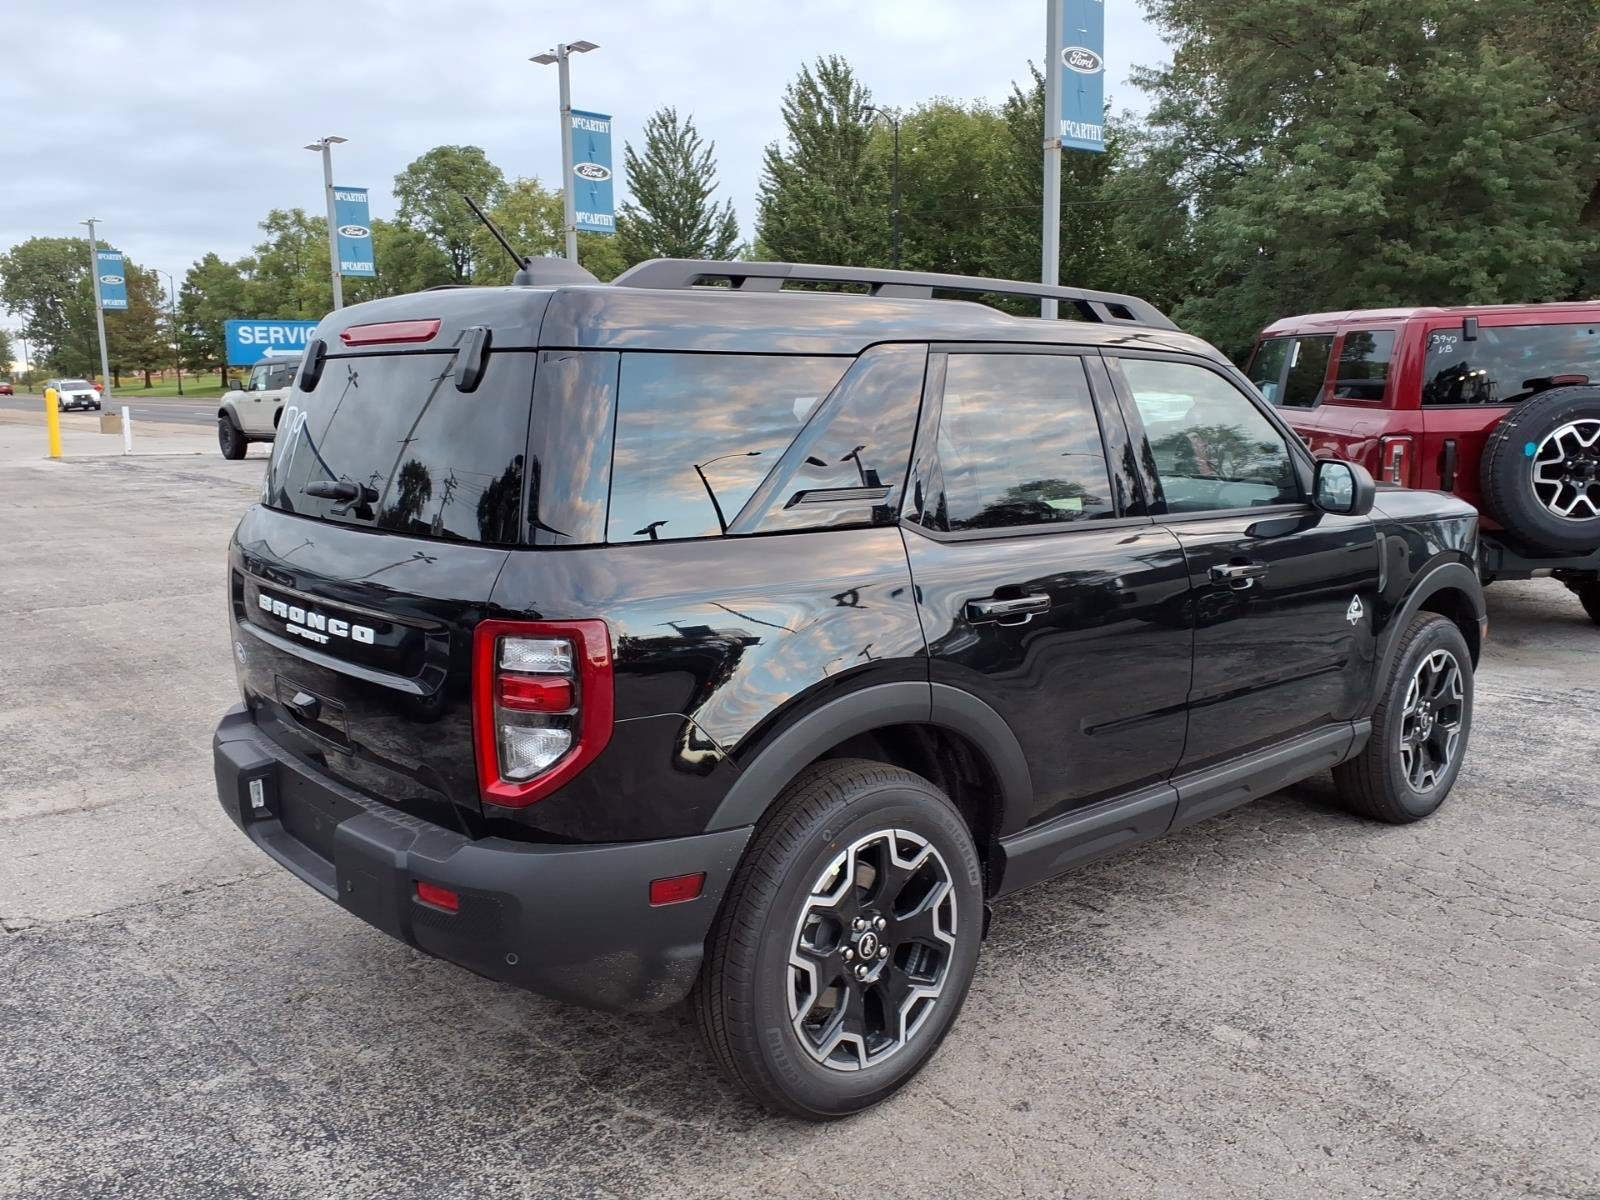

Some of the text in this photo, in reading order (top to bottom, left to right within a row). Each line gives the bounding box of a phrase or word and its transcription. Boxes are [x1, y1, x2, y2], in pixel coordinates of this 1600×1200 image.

[1070, 51, 1093, 69] Ford
[1060, 120, 1102, 140] McCARTHY
[258, 593, 375, 645] BRONCO
[285, 623, 330, 645] SPORT
